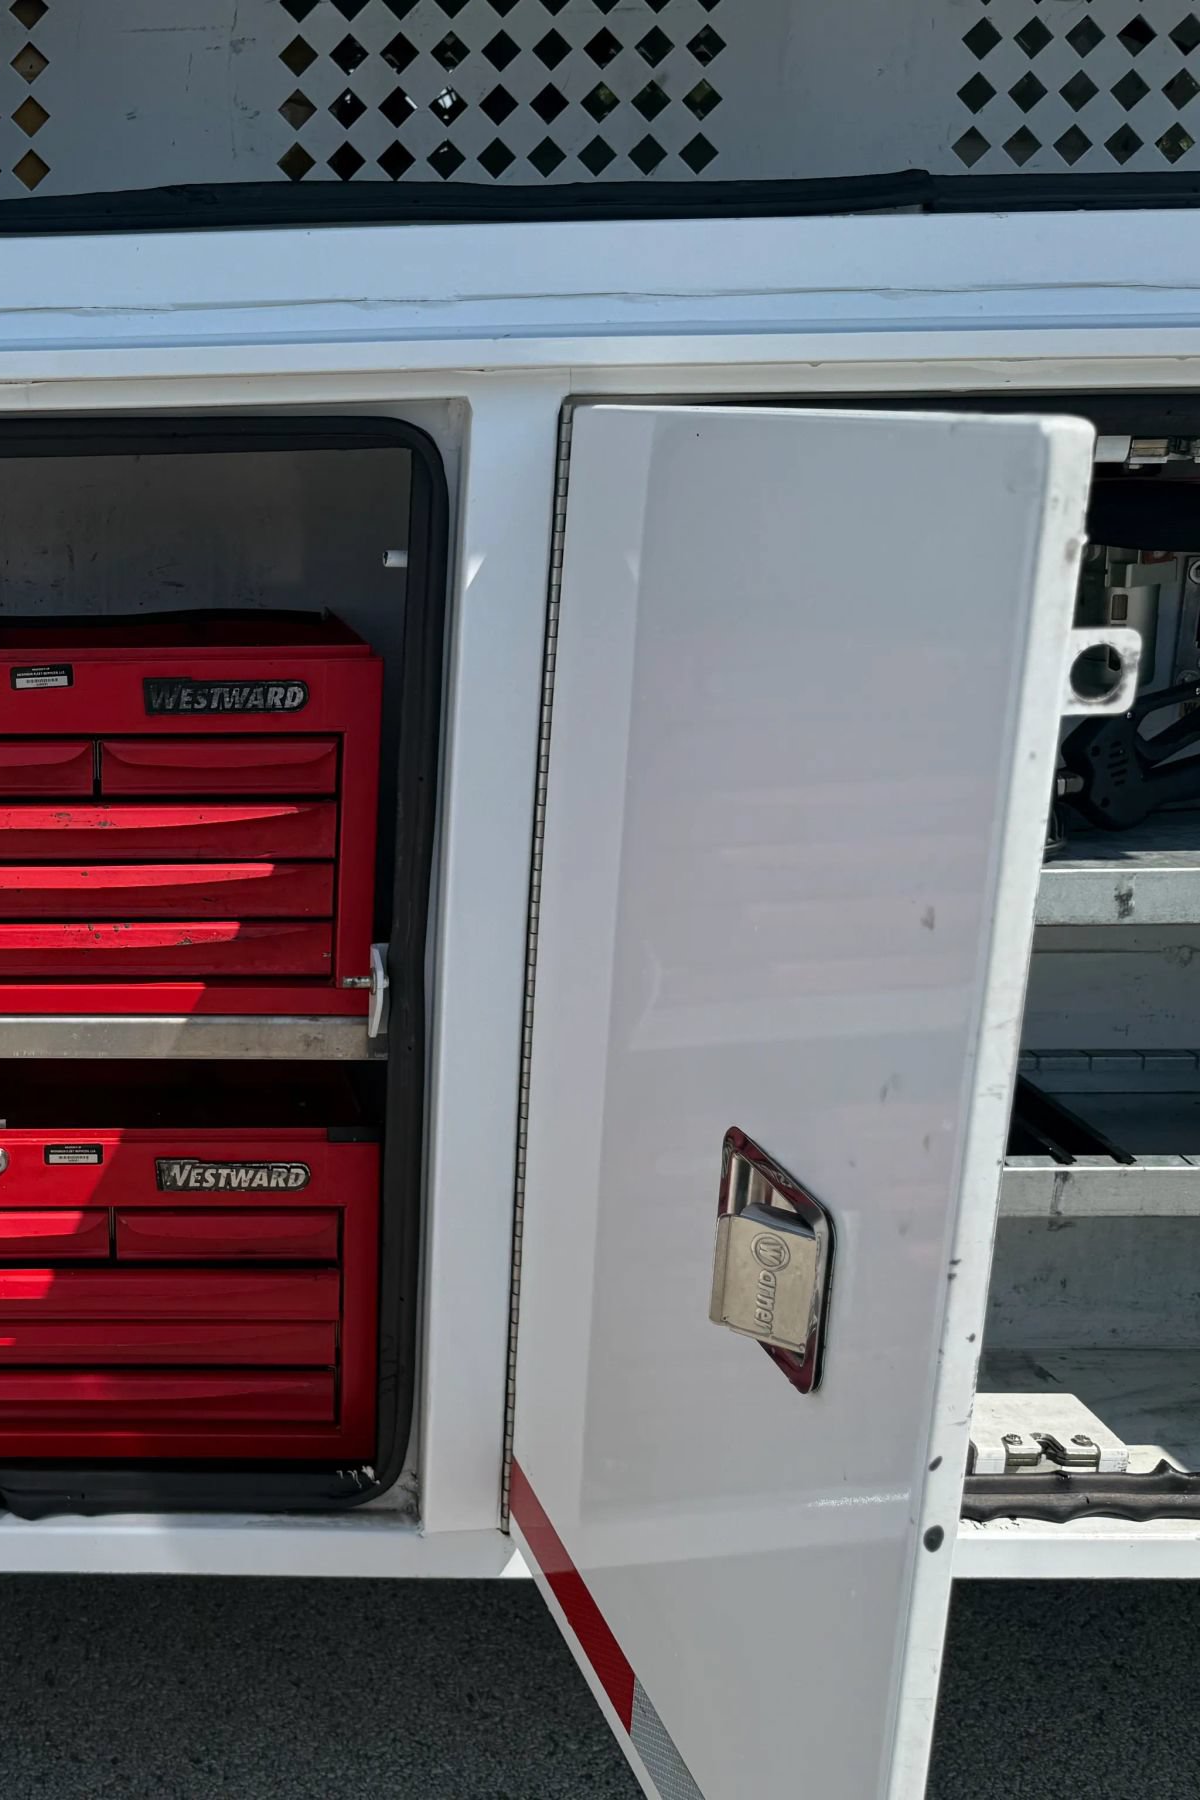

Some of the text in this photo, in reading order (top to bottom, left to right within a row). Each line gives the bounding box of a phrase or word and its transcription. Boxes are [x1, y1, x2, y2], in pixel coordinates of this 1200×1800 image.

[151, 685, 304, 710] WESTWARD
[160, 1164, 306, 1187] WESTWARD
[752, 1233, 791, 1335] Warner
